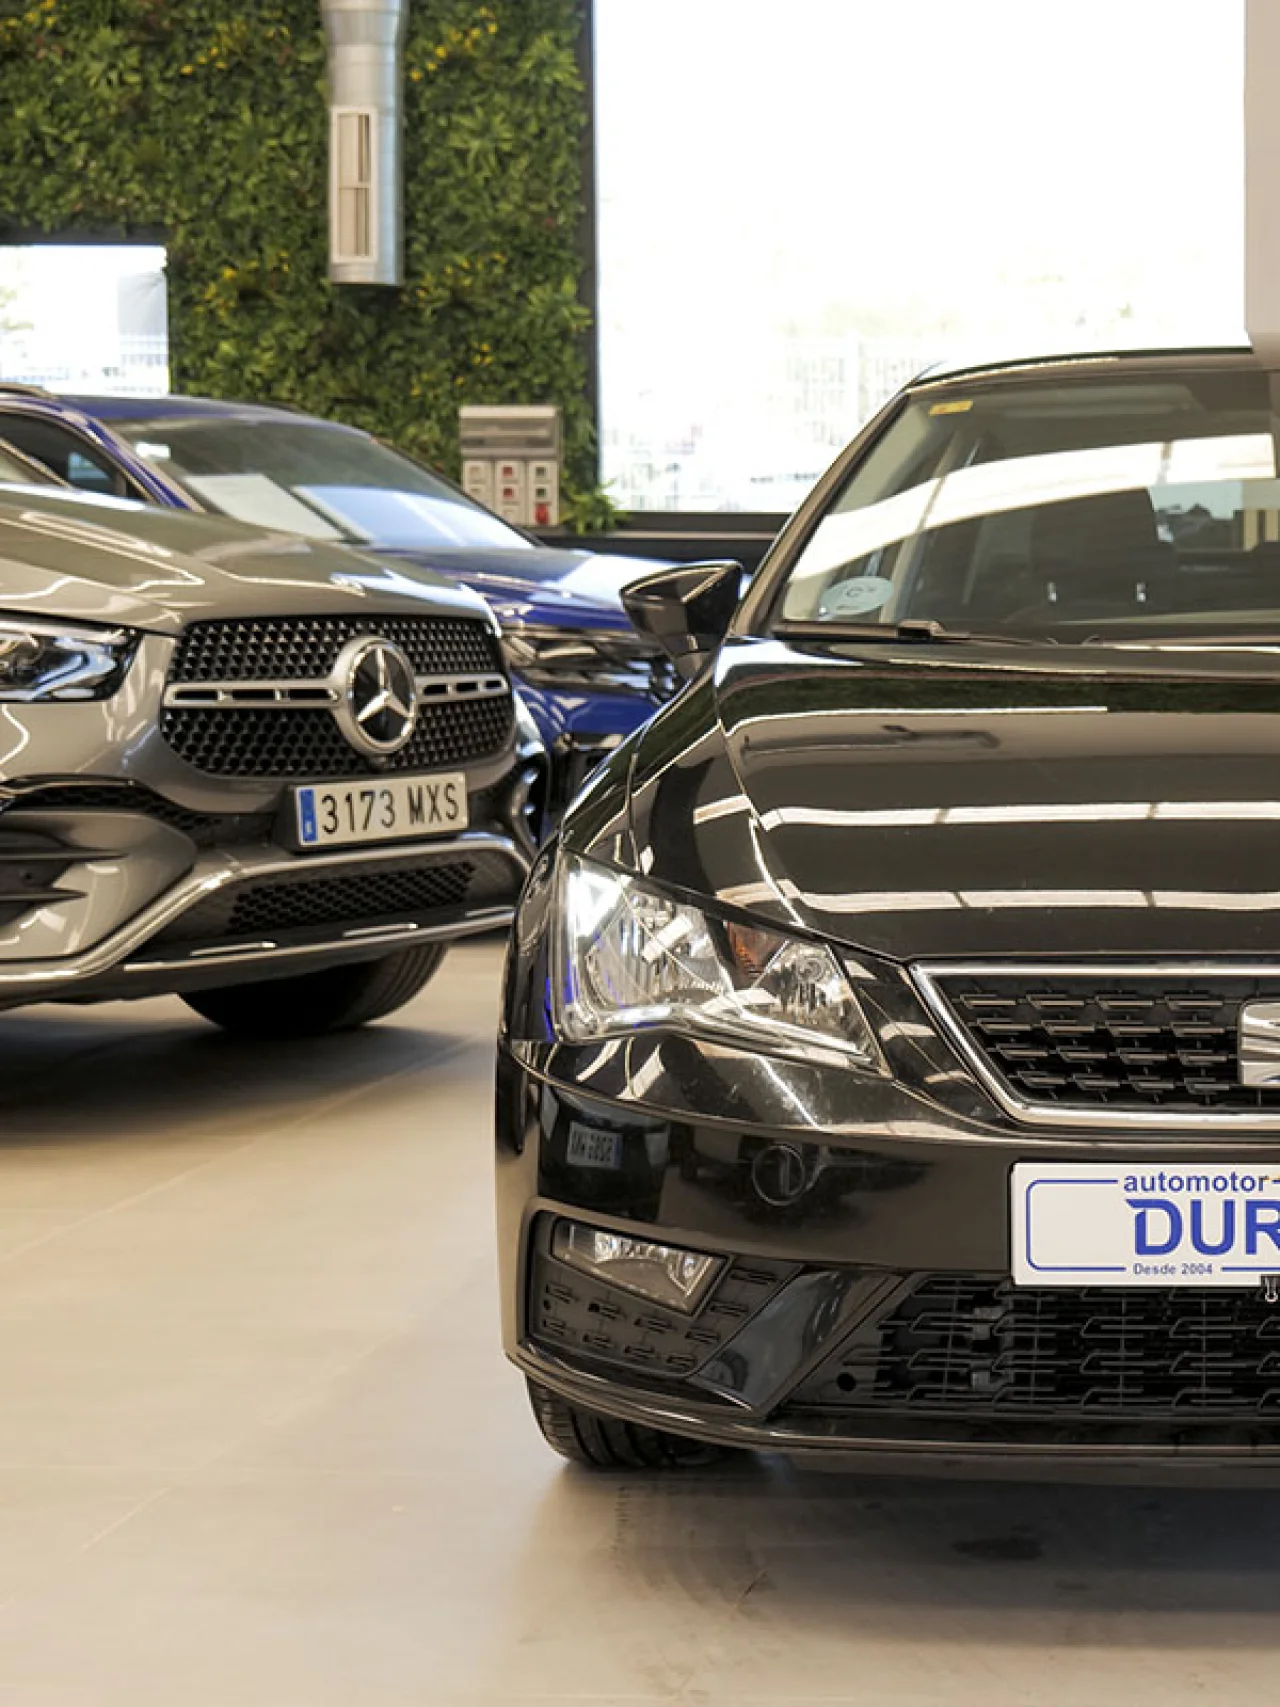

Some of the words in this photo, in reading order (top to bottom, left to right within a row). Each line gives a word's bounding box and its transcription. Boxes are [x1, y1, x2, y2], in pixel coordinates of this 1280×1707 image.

[321, 789, 396, 834] 3173
[407, 783, 459, 825] MXS
[1123, 1171, 1269, 1192] automotor
[1133, 1262, 1176, 1275] Desde
[1181, 1262, 1213, 1275] 2004
